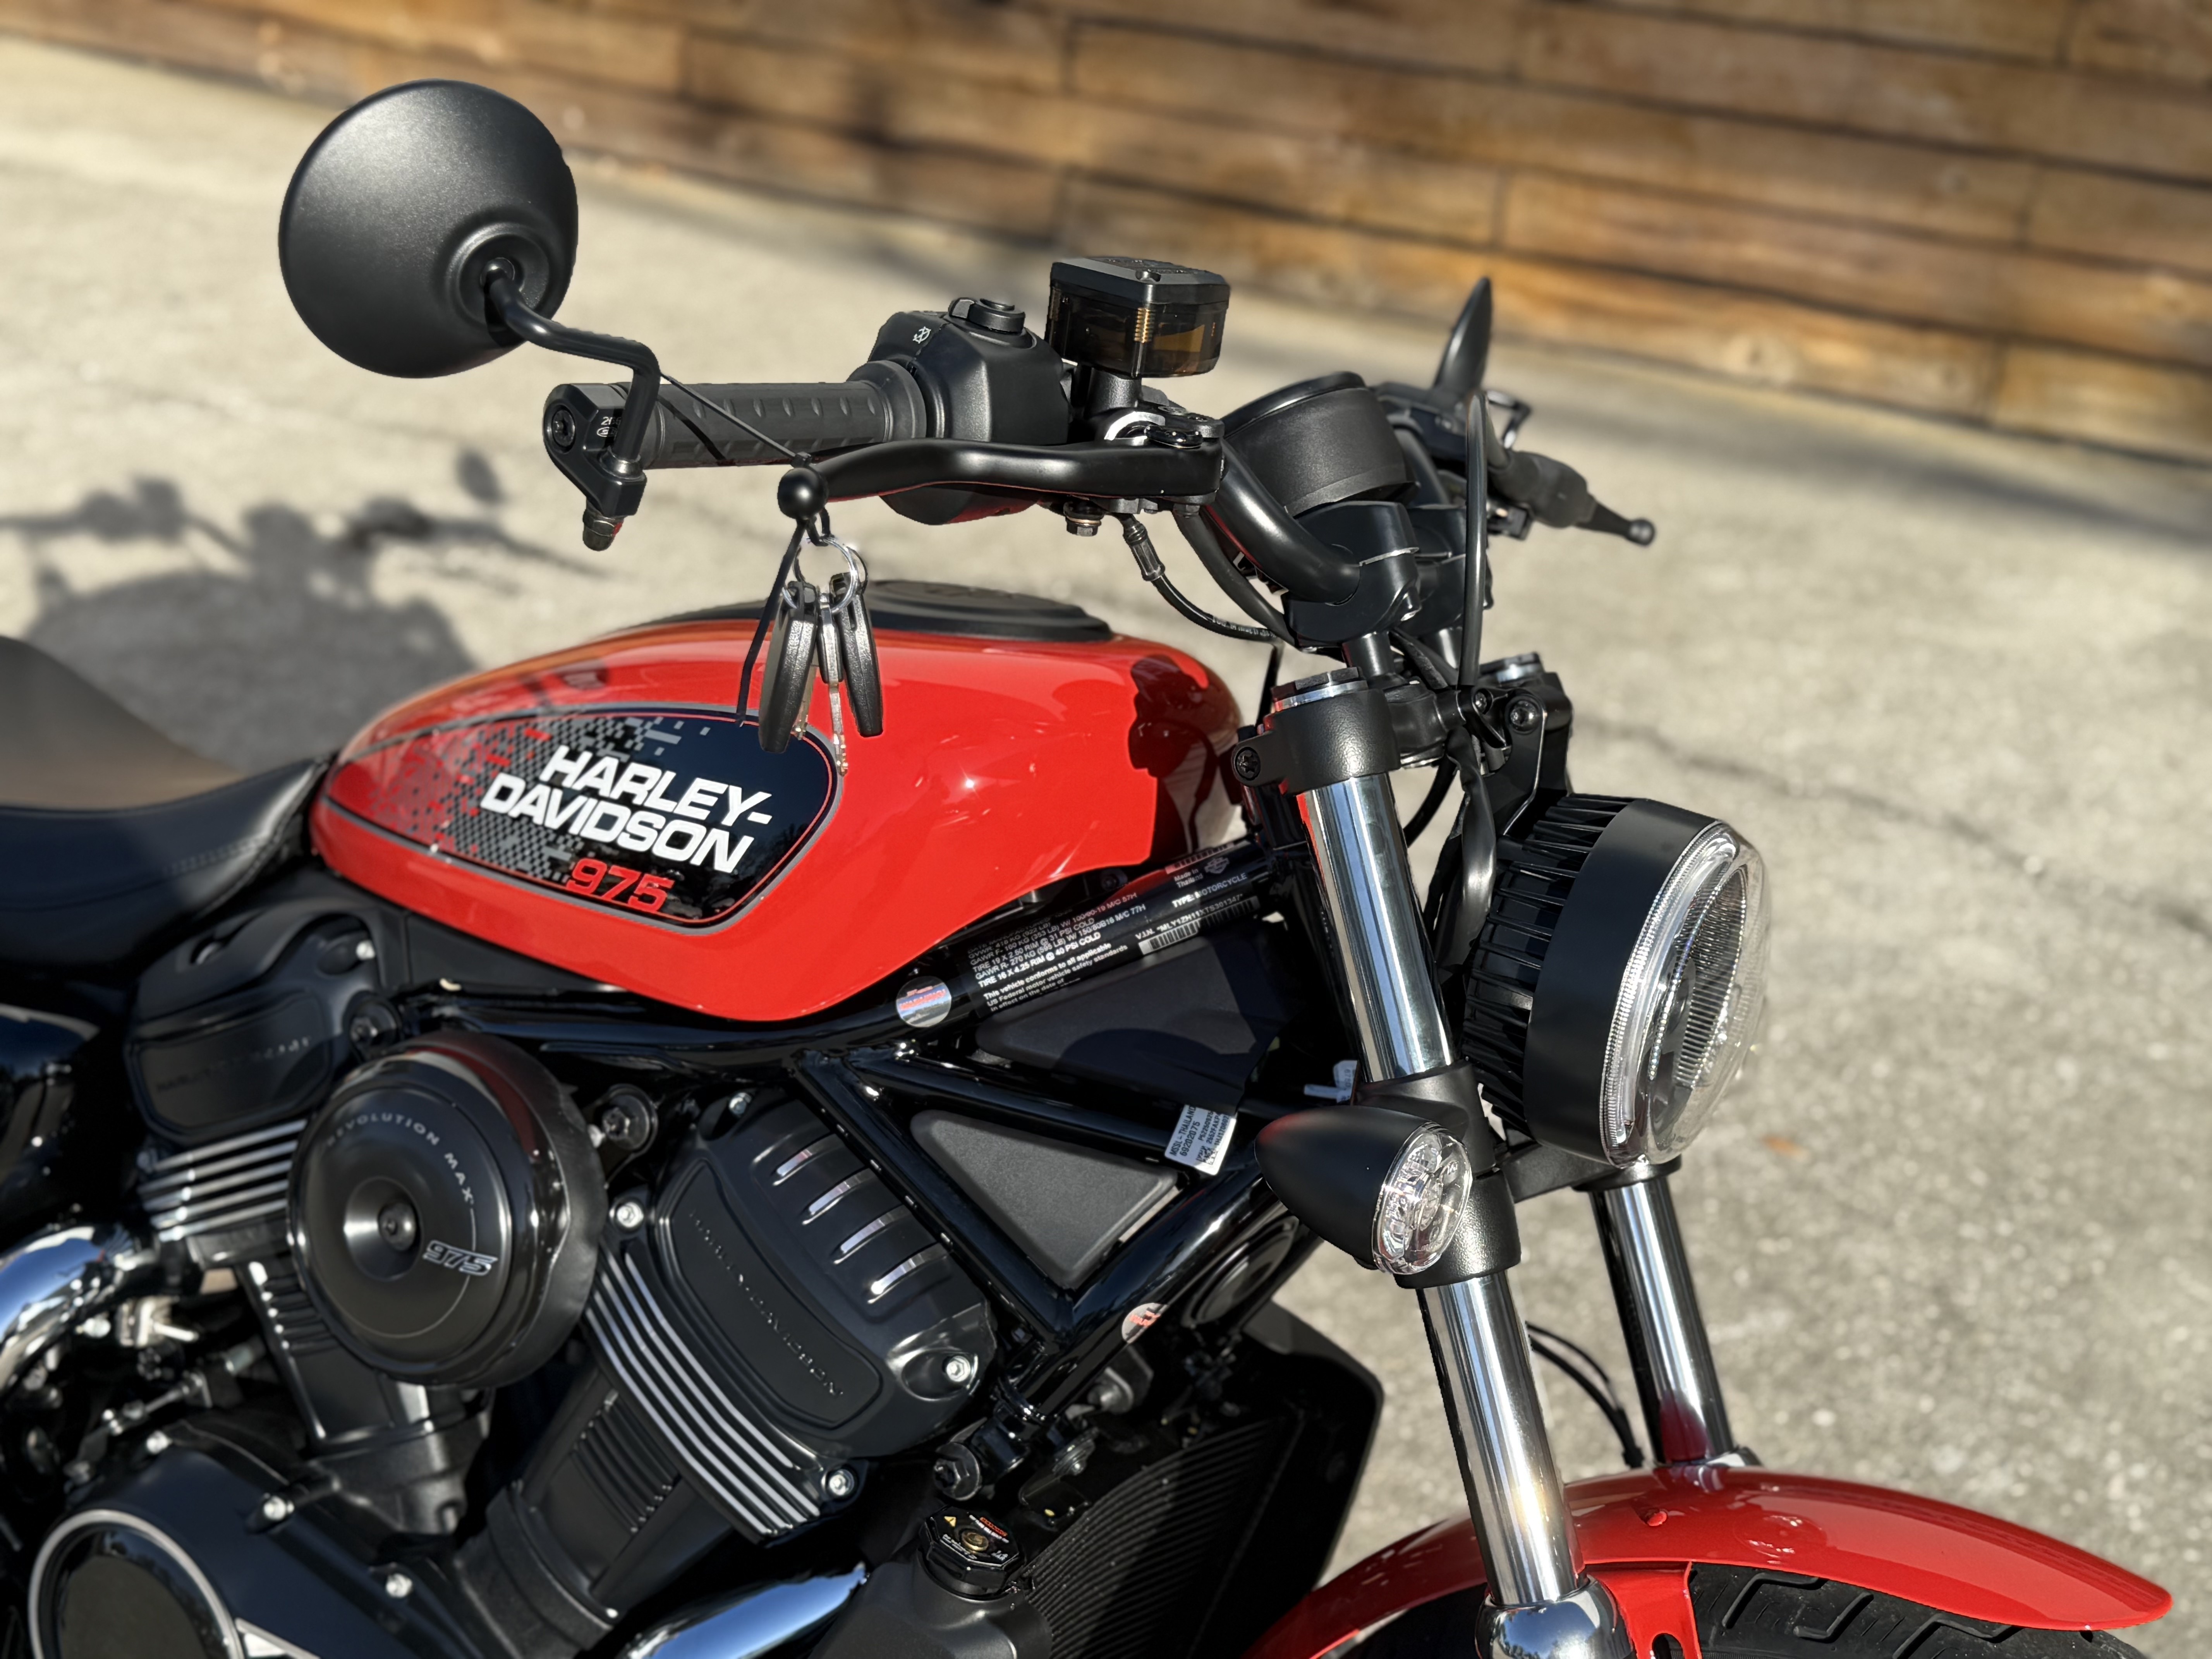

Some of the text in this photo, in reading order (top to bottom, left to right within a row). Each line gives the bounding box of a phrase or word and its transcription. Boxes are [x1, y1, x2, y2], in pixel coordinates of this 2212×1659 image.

[539, 745, 773, 827] HARLEY-
[480, 772, 755, 874] DAVIDSON
[566, 858, 675, 912] 975
[1171, 873, 1247, 907] TYPE: MOTORCYCLE
[1174, 871, 1192, 881] Made
[1177, 874, 1203, 887] Thailand
[970, 951, 994, 965] GAWR
[1018, 937, 1029, 945] KG
[1047, 924, 1059, 933] LB)
[1106, 898, 1121, 908] M/C
[973, 962, 990, 972] TIRE
[1024, 941, 1039, 951] RIM
[1059, 927, 1072, 936] PSI
[1073, 918, 1094, 930] COLD
[975, 966, 1000, 979] GAWR
[1010, 956, 1023, 965] 270
[1024, 950, 1036, 959] KG
[1053, 938, 1066, 948] LB)
[1115, 910, 1130, 921] M/C
[1130, 903, 1146, 914] 77H
[1022, 927, 1037, 937] (922
[978, 976, 996, 987] TIRE
[1013, 962, 1029, 972] 4.25
[1030, 956, 1045, 966] RIM
[1046, 951, 1054, 960] @
[1055, 947, 1065, 955] 40
[1065, 941, 1078, 951] PSI
[1079, 932, 1101, 945] COLD
[983, 989, 999, 1000] This
[1000, 979, 1024, 992] vehicle
[1025, 965, 1057, 982] conforms
[1076, 942, 1112, 961] applicable
[999, 988, 1025, 1001] Federal
[1026, 979, 1046, 990] motor
[1047, 968, 1071, 981] vehicle
[1072, 960, 1093, 972] safety
[1093, 944, 1128, 962] standards
[999, 998, 1017, 1008] effect
[1041, 982, 1056, 990] date
[326, 1113, 440, 1146] REVOLUTION
[1180, 1121, 1200, 1156] 69202075
[422, 1240, 498, 1276] 975
